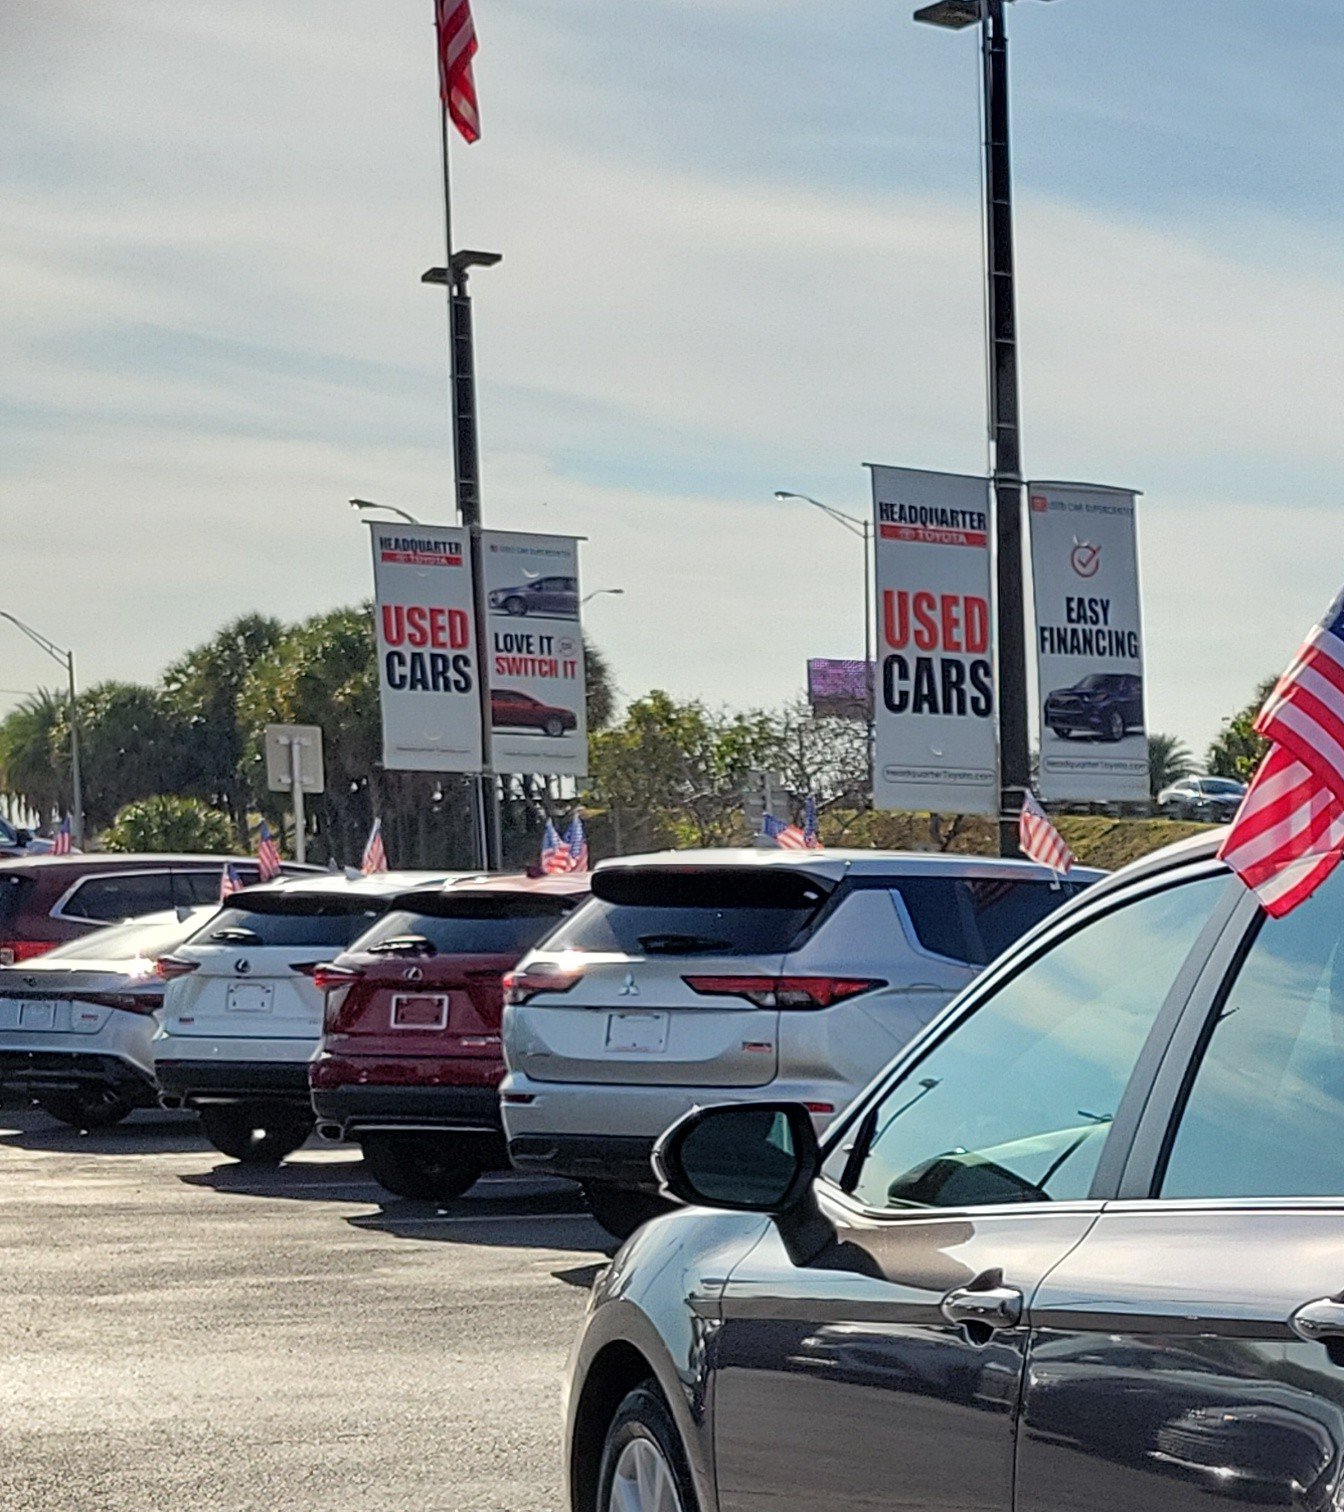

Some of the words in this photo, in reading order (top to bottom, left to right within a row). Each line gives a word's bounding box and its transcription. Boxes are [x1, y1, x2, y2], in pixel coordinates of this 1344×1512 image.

[878, 501, 987, 531] HEADQUARTER
[379, 536, 462, 556] HEADQUARTER
[918, 531, 968, 545] TOYOTA
[882, 589, 989, 654] USED
[1065, 596, 1111, 626] EASY
[382, 604, 470, 650] USED
[1040, 625, 1140, 659] FINANCING
[494, 632, 534, 654] LOVE
[538, 635, 554, 656] IT
[386, 650, 473, 694] CARS
[495, 656, 559, 678] SWITCH
[563, 660, 578, 680] IT
[882, 654, 993, 718] CARS
